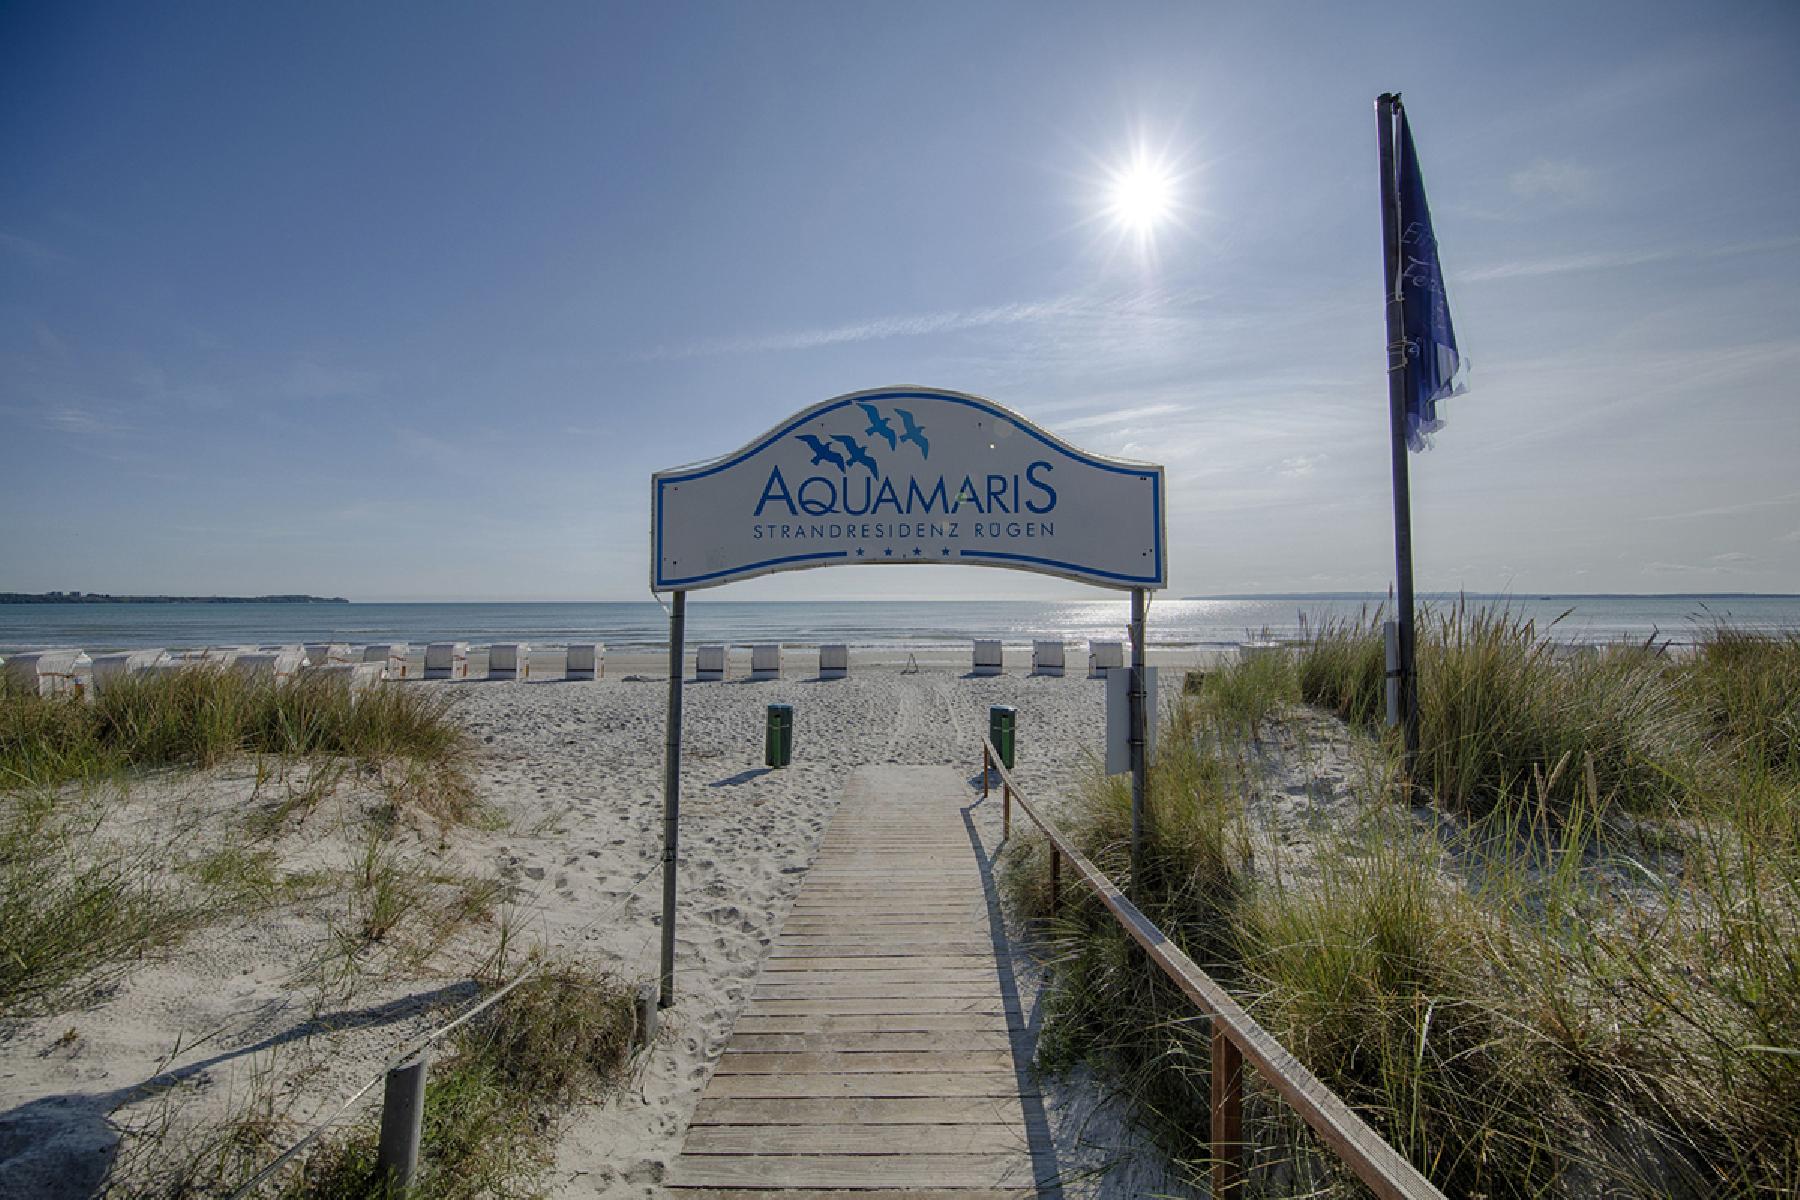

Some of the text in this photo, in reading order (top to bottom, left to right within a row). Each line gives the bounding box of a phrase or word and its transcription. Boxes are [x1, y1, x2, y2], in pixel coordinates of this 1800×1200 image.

[753, 461, 1057, 516] AQUAMARIS
[753, 522, 1055, 539] STRANDRESIDENZ RÜGEN
